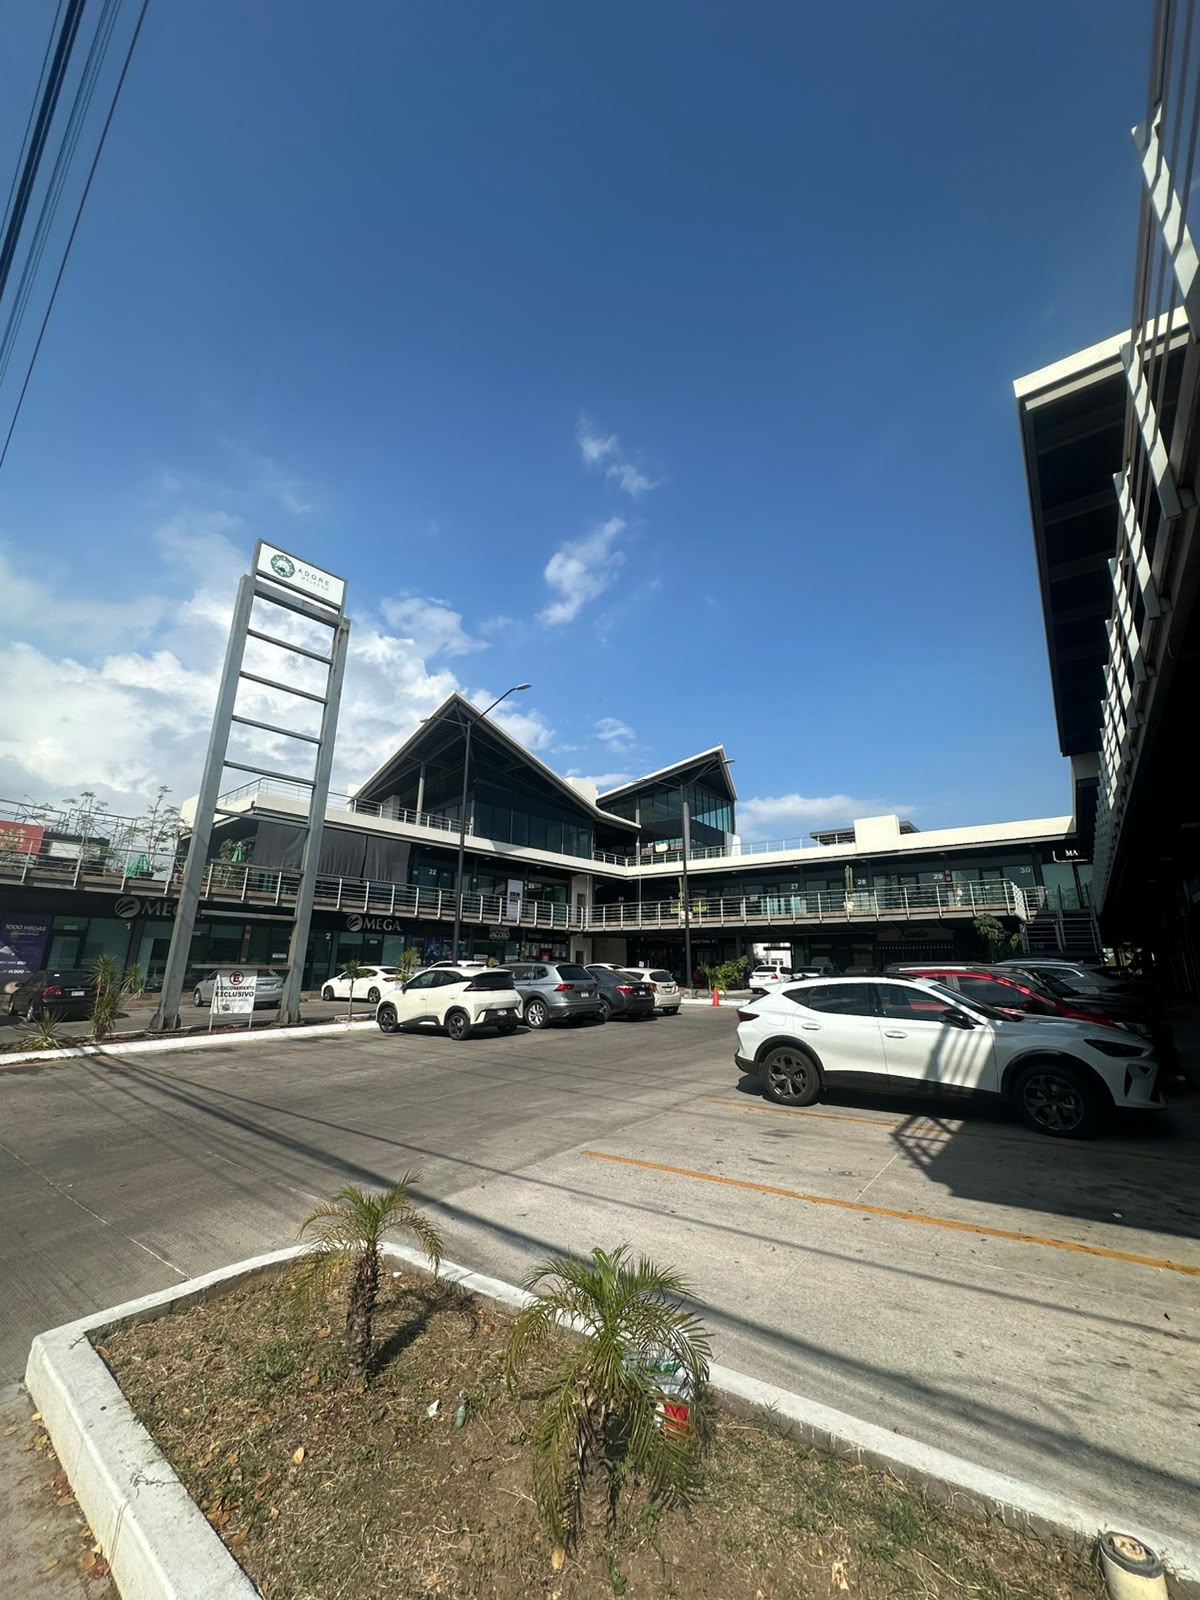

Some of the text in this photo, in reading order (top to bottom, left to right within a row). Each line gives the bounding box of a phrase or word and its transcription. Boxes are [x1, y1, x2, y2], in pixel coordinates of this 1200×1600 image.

[298, 568, 330, 587] ADORE
[125, 922, 131, 930] 1
[363, 917, 401, 931] MEGA
[325, 932, 331, 940] 2
[233, 974, 241, 983] E
